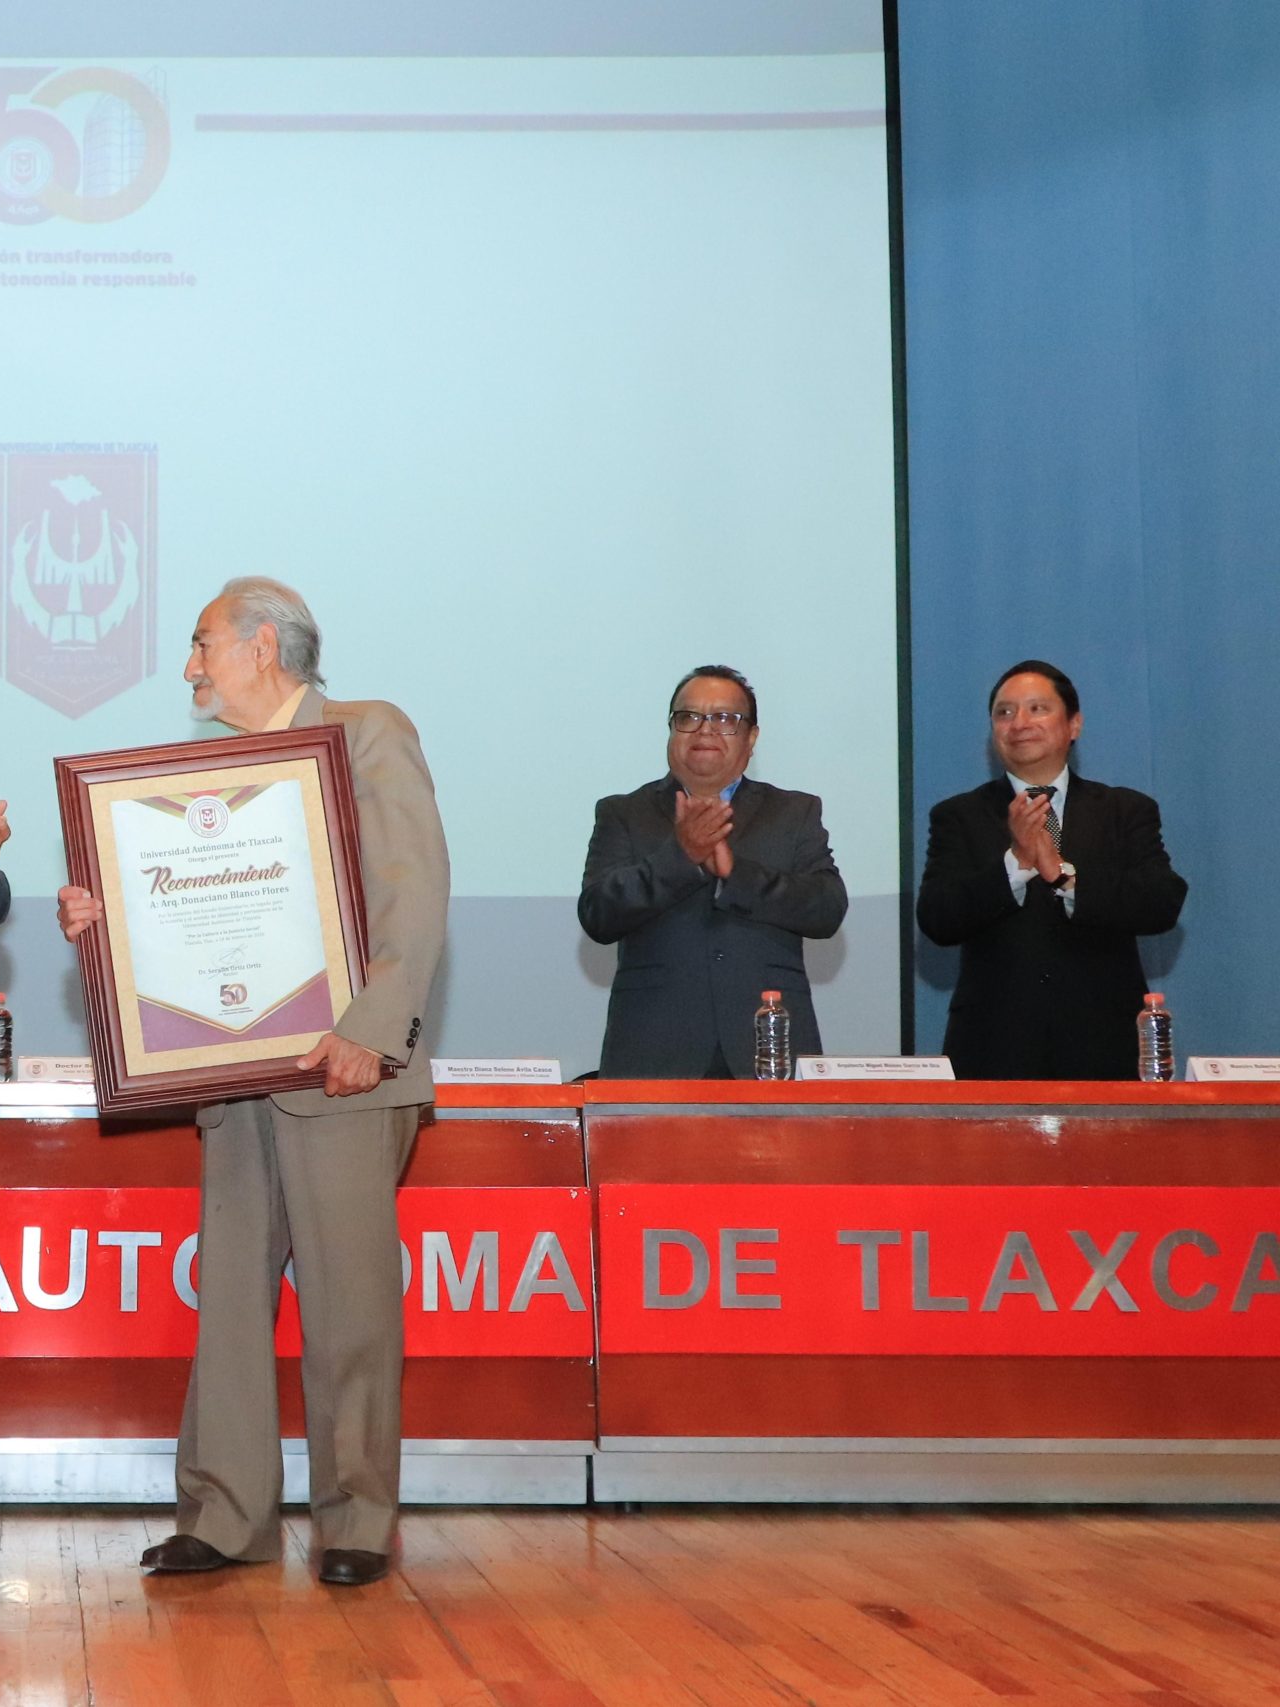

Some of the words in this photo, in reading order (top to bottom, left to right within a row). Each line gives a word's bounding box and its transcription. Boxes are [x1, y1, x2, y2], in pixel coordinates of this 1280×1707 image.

[26, 249, 174, 264] transformadora
[83, 272, 197, 289] responsable
[140, 847, 190, 860] Universidad
[192, 842, 234, 854] Autónoma
[236, 840, 247, 848] de
[248, 836, 283, 847] Tlaxcala
[140, 861, 290, 895] Reconocimiento
[161, 899, 180, 908] Arq.
[181, 893, 228, 905] Donaciano
[230, 890, 260, 900] Blanco
[262, 886, 289, 896] Flores
[642, 1228, 781, 1312] DE
[837, 1228, 1280, 1313] TLAXCA
